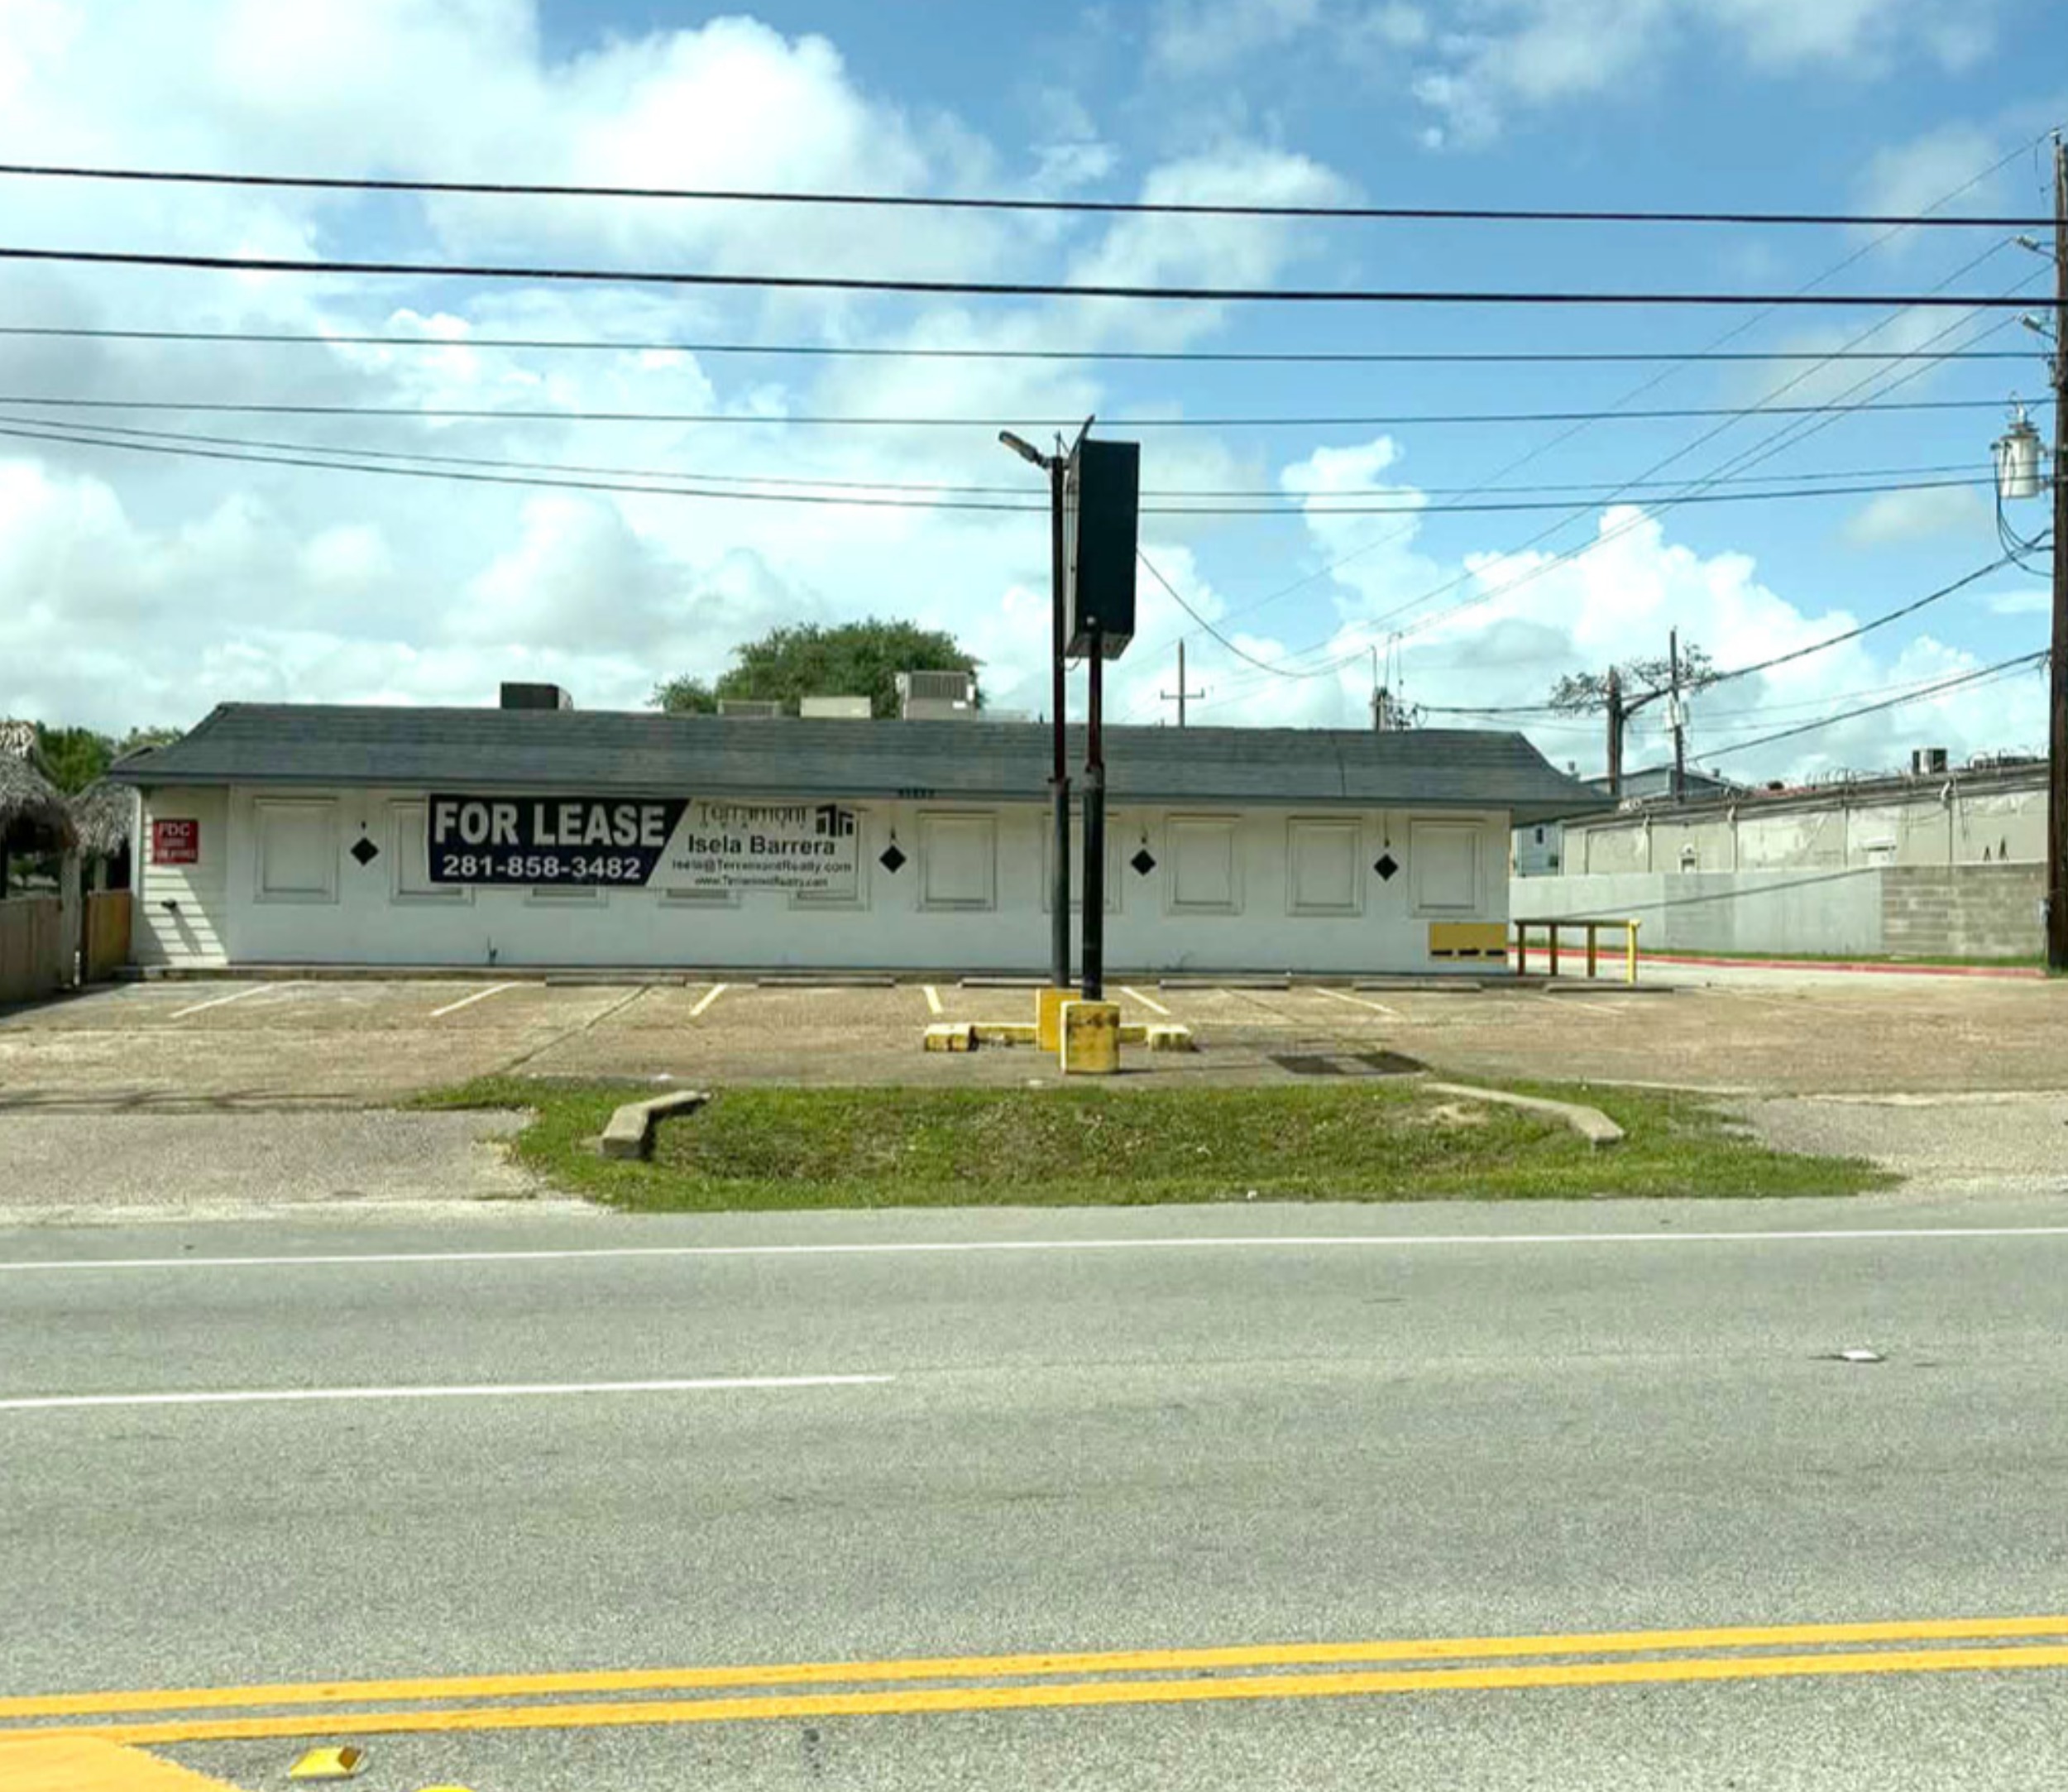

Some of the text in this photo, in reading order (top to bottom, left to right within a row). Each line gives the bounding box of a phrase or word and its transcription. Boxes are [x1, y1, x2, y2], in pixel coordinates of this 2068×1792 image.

[434, 802, 665, 847] FOR LEASE
[688, 834, 835, 855] Isela Barrera
[443, 854, 641, 879] 281-858-3482
